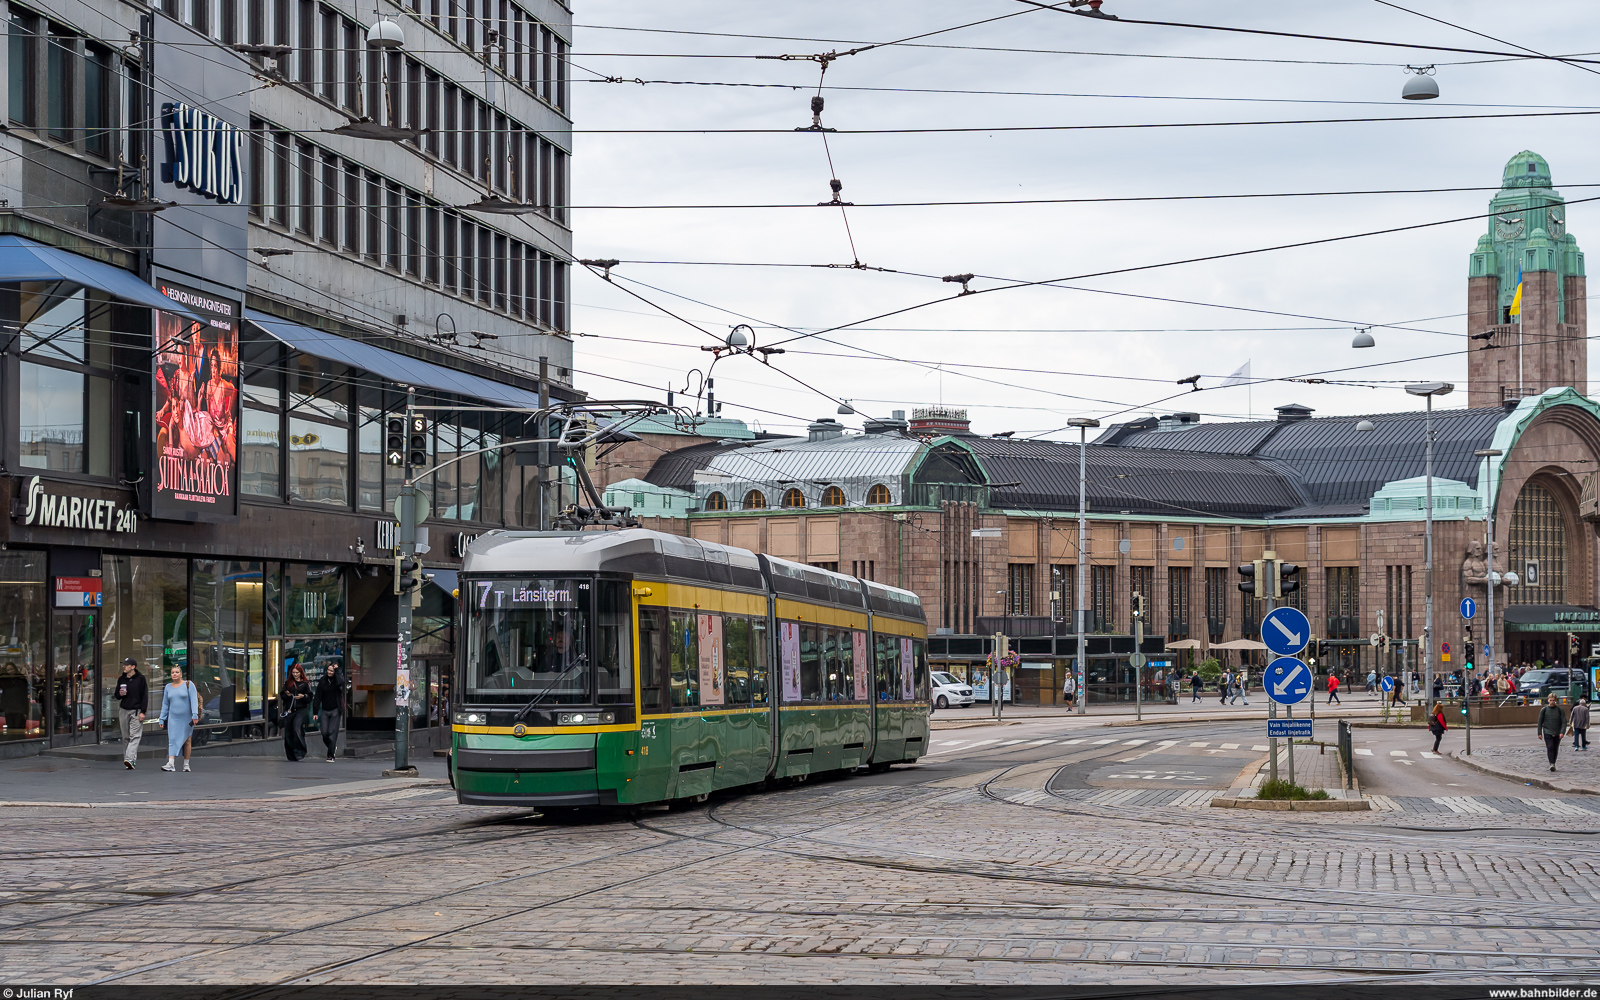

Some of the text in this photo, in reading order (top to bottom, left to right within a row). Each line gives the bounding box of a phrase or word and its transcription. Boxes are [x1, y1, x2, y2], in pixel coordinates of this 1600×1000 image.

[175, 102, 244, 205] SOKOS
[167, 287, 190, 305] HELSINGIN
[414, 419, 423, 432] S
[39, 494, 116, 531] MARKET
[116, 509, 137, 533] 24h
[56, 578, 63, 590] M
[512, 587, 572, 602] Länsiterm.
[641, 746, 649, 755] 418
